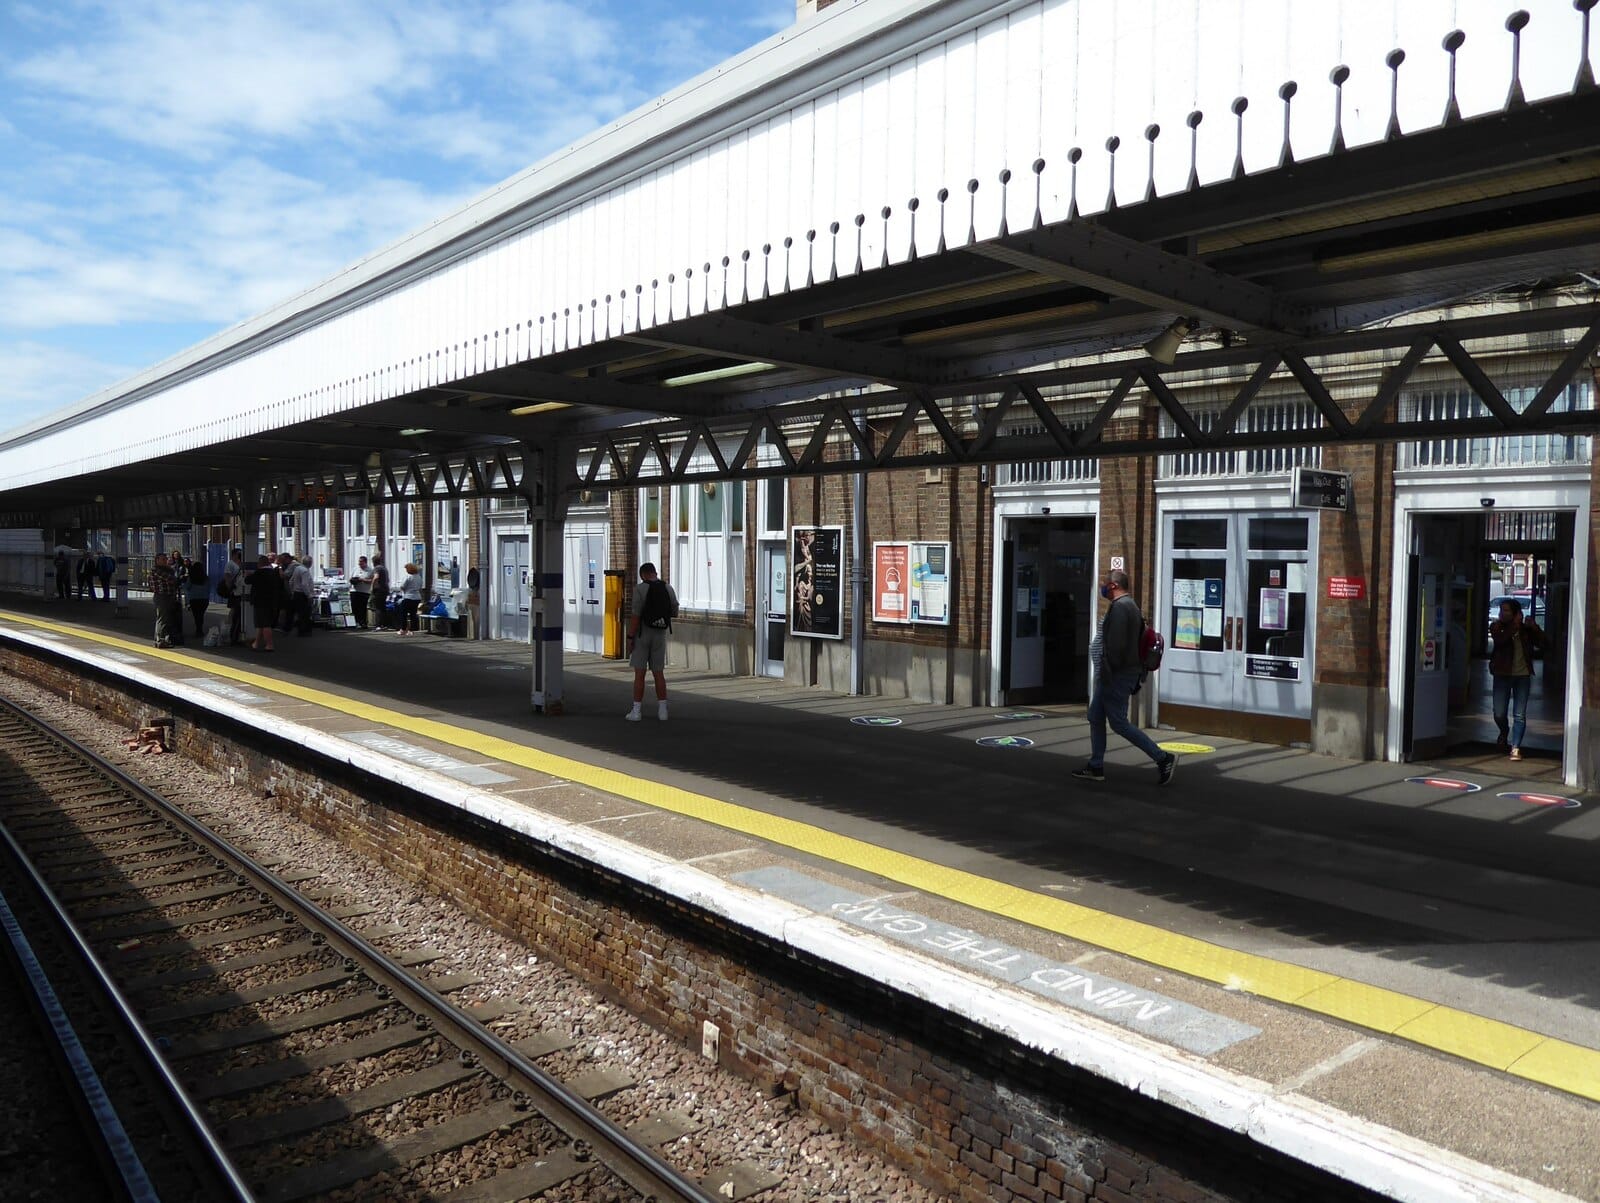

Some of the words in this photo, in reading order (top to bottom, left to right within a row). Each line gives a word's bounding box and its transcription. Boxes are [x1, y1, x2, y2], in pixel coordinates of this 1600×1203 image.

[832, 894, 928, 933] GAP
[923, 930, 1021, 970] THE
[1030, 967, 1172, 1021] MIND
